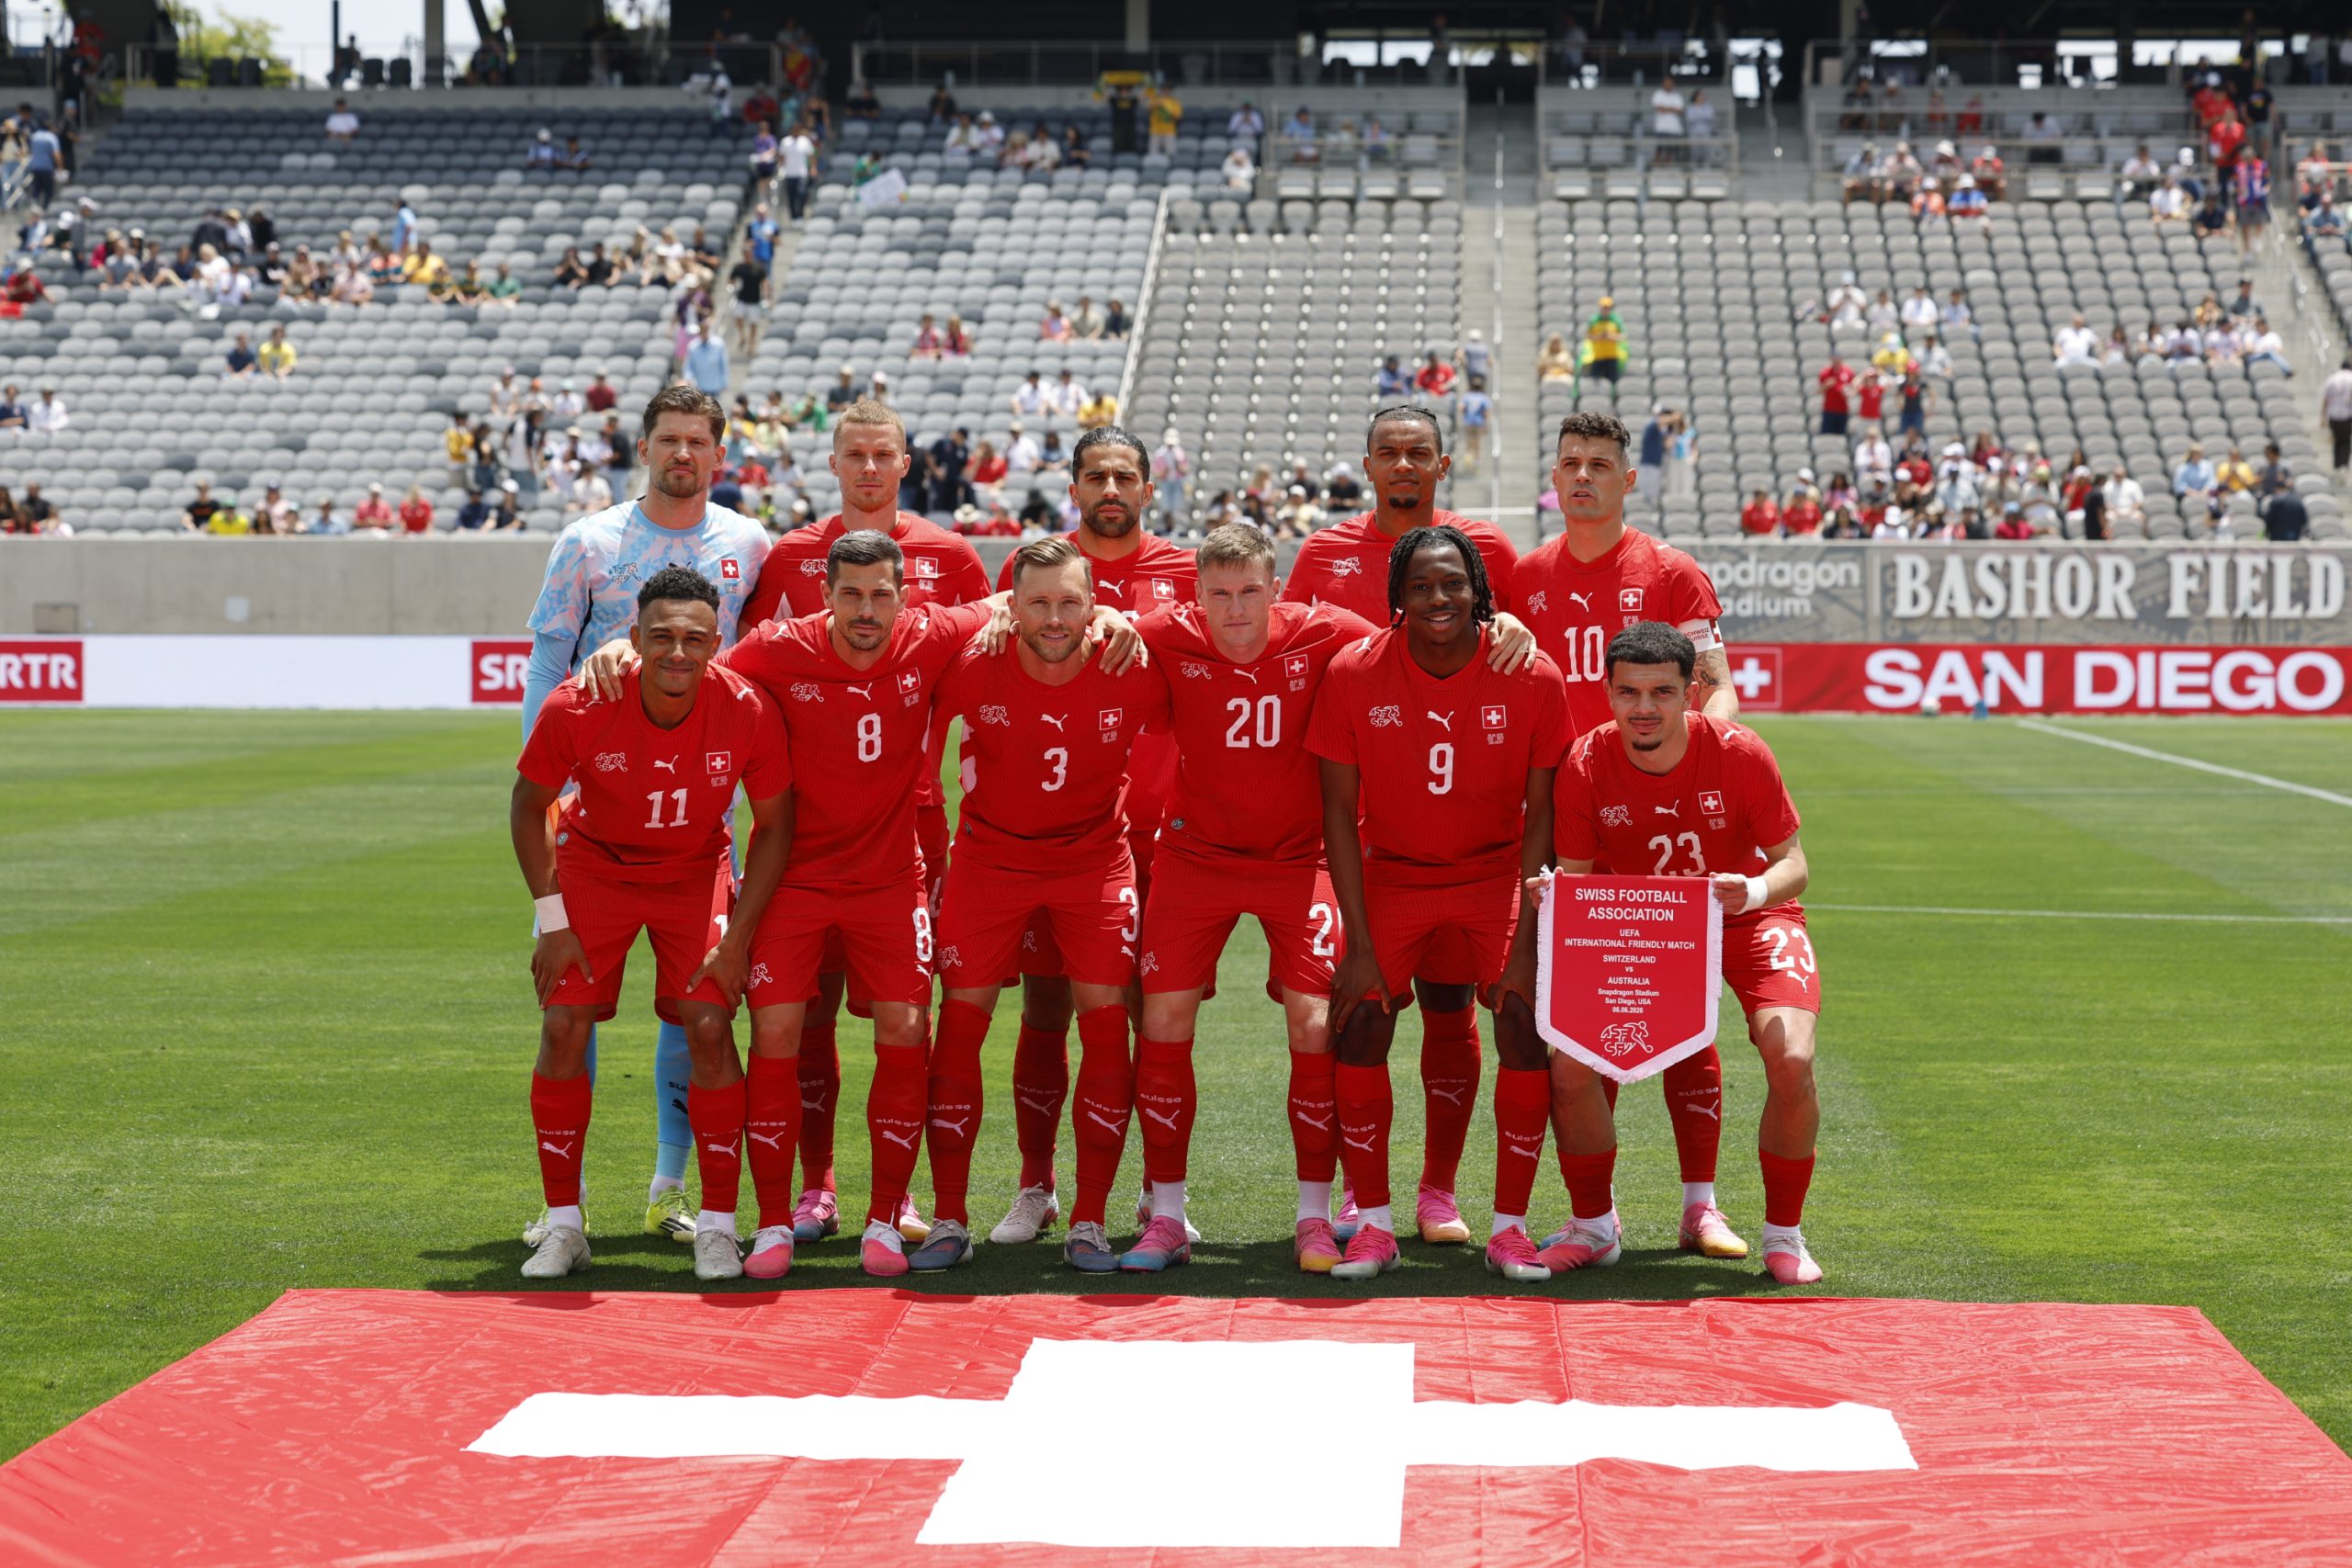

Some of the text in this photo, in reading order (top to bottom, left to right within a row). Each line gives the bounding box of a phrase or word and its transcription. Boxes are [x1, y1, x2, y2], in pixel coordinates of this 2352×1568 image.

[1894, 554, 2345, 619] BASHOR FIELD
[1565, 626, 1605, 682] 10
[0, 653, 77, 689] RTR
[1865, 649, 2346, 712] SAN DIEGO
[1226, 694, 1282, 748] 20
[857, 713, 882, 762] 8
[1041, 747, 1069, 792] 3
[1428, 742, 1454, 795] 9
[644, 788, 689, 829] 11
[1648, 831, 1706, 876] 23
[1575, 888, 1687, 904] SWISS FOOTBALL
[1118, 887, 1138, 942] 3
[1588, 908, 1674, 921] ASSOCIATION
[912, 907, 933, 962] 8
[1619, 929, 1640, 937] UEFA
[1565, 938, 1695, 950] INTERNATIONAL FRIENDLY MATCH
[1761, 927, 1815, 973] 23
[1603, 955, 1656, 964] SWITZERLAND
[1608, 977, 1650, 986] AUSTRALIA
[1598, 988, 1634, 997] Snapdragon
[1618, 998, 1636, 1006] Diego,
[1140, 1093, 1182, 1103] suisse
[1678, 1087, 1720, 1097] suisse
[1084, 1097, 1129, 1114] suisse
[1292, 1098, 1335, 1109] suisse
[876, 1118, 921, 1128] suisse
[538, 1128, 577, 1136] suisse
